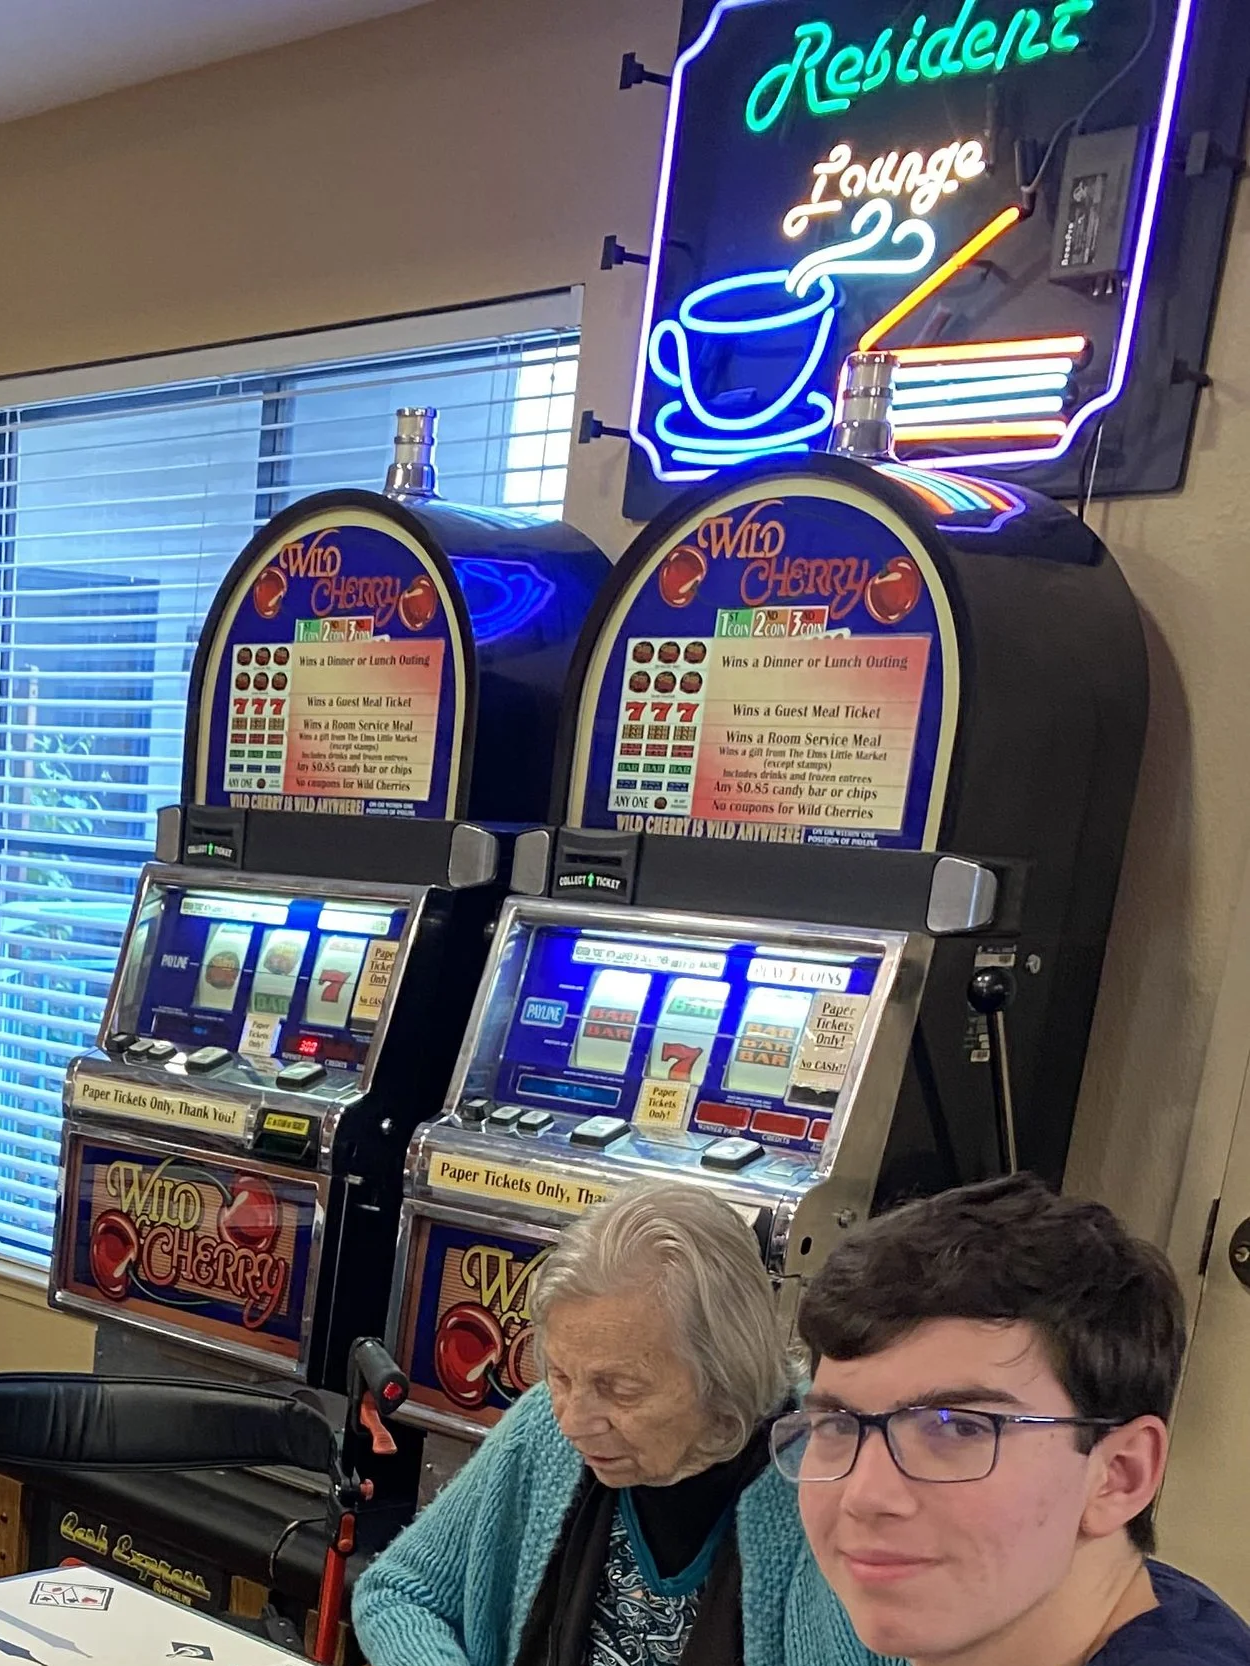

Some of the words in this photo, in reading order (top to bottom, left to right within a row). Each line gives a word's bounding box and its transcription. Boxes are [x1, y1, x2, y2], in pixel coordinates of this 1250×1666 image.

[745, 0, 1094, 132] Resident
[782, 140, 986, 238] Lounge
[697, 499, 786, 559] WILD
[279, 529, 342, 578] WILD
[740, 556, 869, 620] CHERRY
[311, 576, 400, 628] CHERRY
[299, 656, 317, 666] Wins
[327, 655, 355, 666] Dinner
[357, 658, 366, 666] or
[369, 655, 396, 666] Lunch
[399, 655, 430, 667] Outing
[722, 655, 748, 668] Wins
[752, 659, 759, 668] a
[763, 655, 801, 669] Dinner
[807, 659, 819, 669] or
[824, 655, 860, 669] Lunch
[865, 655, 908, 671] Outing
[307, 696, 326, 707] Wins
[329, 699, 334, 707] a
[336, 696, 359, 707] Guest
[362, 697, 382, 707] Meal
[385, 697, 412, 707] Ticket
[625, 701, 647, 722] 7
[651, 702, 673, 722] 7
[677, 703, 700, 723] 7
[733, 703, 760, 717] Wins
[763, 707, 770, 716] a
[775, 705, 808, 718] Guest
[812, 705, 840, 719] Meal
[844, 706, 881, 719] Ticket
[303, 719, 322, 730] Wins
[332, 719, 356, 730] Room
[358, 719, 389, 731] Service
[393, 720, 413, 731] Meal
[726, 730, 753, 744] Wins
[757, 735, 764, 744] a
[768, 731, 801, 745] Room
[805, 733, 848, 747] Service
[852, 734, 882, 747] Meal
[719, 747, 737, 756] Wins
[749, 748, 763, 759] gift
[765, 748, 785, 758] from
[789, 749, 804, 758] The
[806, 749, 827, 760] Elms
[830, 750, 853, 760] Little
[855, 751, 887, 761] Market
[763, 759, 793, 770] (except
[797, 760, 832, 771] stamps)
[723, 769, 758, 779] Includes
[760, 770, 787, 780] drinks
[790, 772, 805, 781] and
[808, 773, 836, 783] frozen
[839, 775, 872, 784] entrees
[713, 781, 732, 793] Any
[736, 781, 769, 794] $0.85
[772, 784, 804, 798] candy
[808, 785, 826, 797] bar
[830, 788, 844, 798] or
[846, 787, 878, 801] chips
[614, 796, 631, 808] ANY
[632, 797, 649, 809] ONE
[712, 800, 726, 811] No
[729, 803, 775, 815] coupons
[778, 803, 794, 815] for
[797, 804, 821, 817] Wild
[824, 805, 874, 819] Cherries
[616, 814, 643, 832] WILD
[645, 816, 689, 836] CHERRY
[690, 818, 704, 837] IS
[707, 820, 736, 840] WILD
[736, 823, 805, 844] ANYWHERE!
[559, 875, 586, 887] COLLECT
[596, 876, 620, 890] TICKET
[160, 954, 189, 969] PAYLINE
[319, 969, 351, 1003] 7
[256, 994, 288, 1013] BAR
[822, 1001, 857, 1016] Paper
[526, 1003, 562, 1023] PAYLINE
[589, 1009, 635, 1022] BAR
[747, 1023, 795, 1038] BAR
[816, 1017, 854, 1031] Tickets
[586, 1025, 630, 1040] BAR
[816, 1033, 846, 1047] Only!
[742, 1038, 789, 1052] BAR
[661, 1042, 703, 1082] 7
[739, 1051, 786, 1066] BAR
[801, 1060, 812, 1069] No
[652, 1086, 679, 1098] Paper
[82, 1084, 111, 1101] Paper
[114, 1089, 147, 1108] Tickets
[150, 1096, 174, 1114] Only,
[178, 1101, 209, 1120] Thank
[212, 1107, 237, 1124] You!
[648, 1098, 677, 1109] Tickets
[648, 1109, 671, 1121] Only!
[440, 1162, 480, 1183] Paper
[484, 1170, 531, 1193] Tickets
[536, 1180, 570, 1204] Only,
[106, 1156, 202, 1231] WILD
[140, 1231, 287, 1330] CHERRY
[60, 1511, 109, 1556] Cash
[112, 1534, 212, 1601] Express
